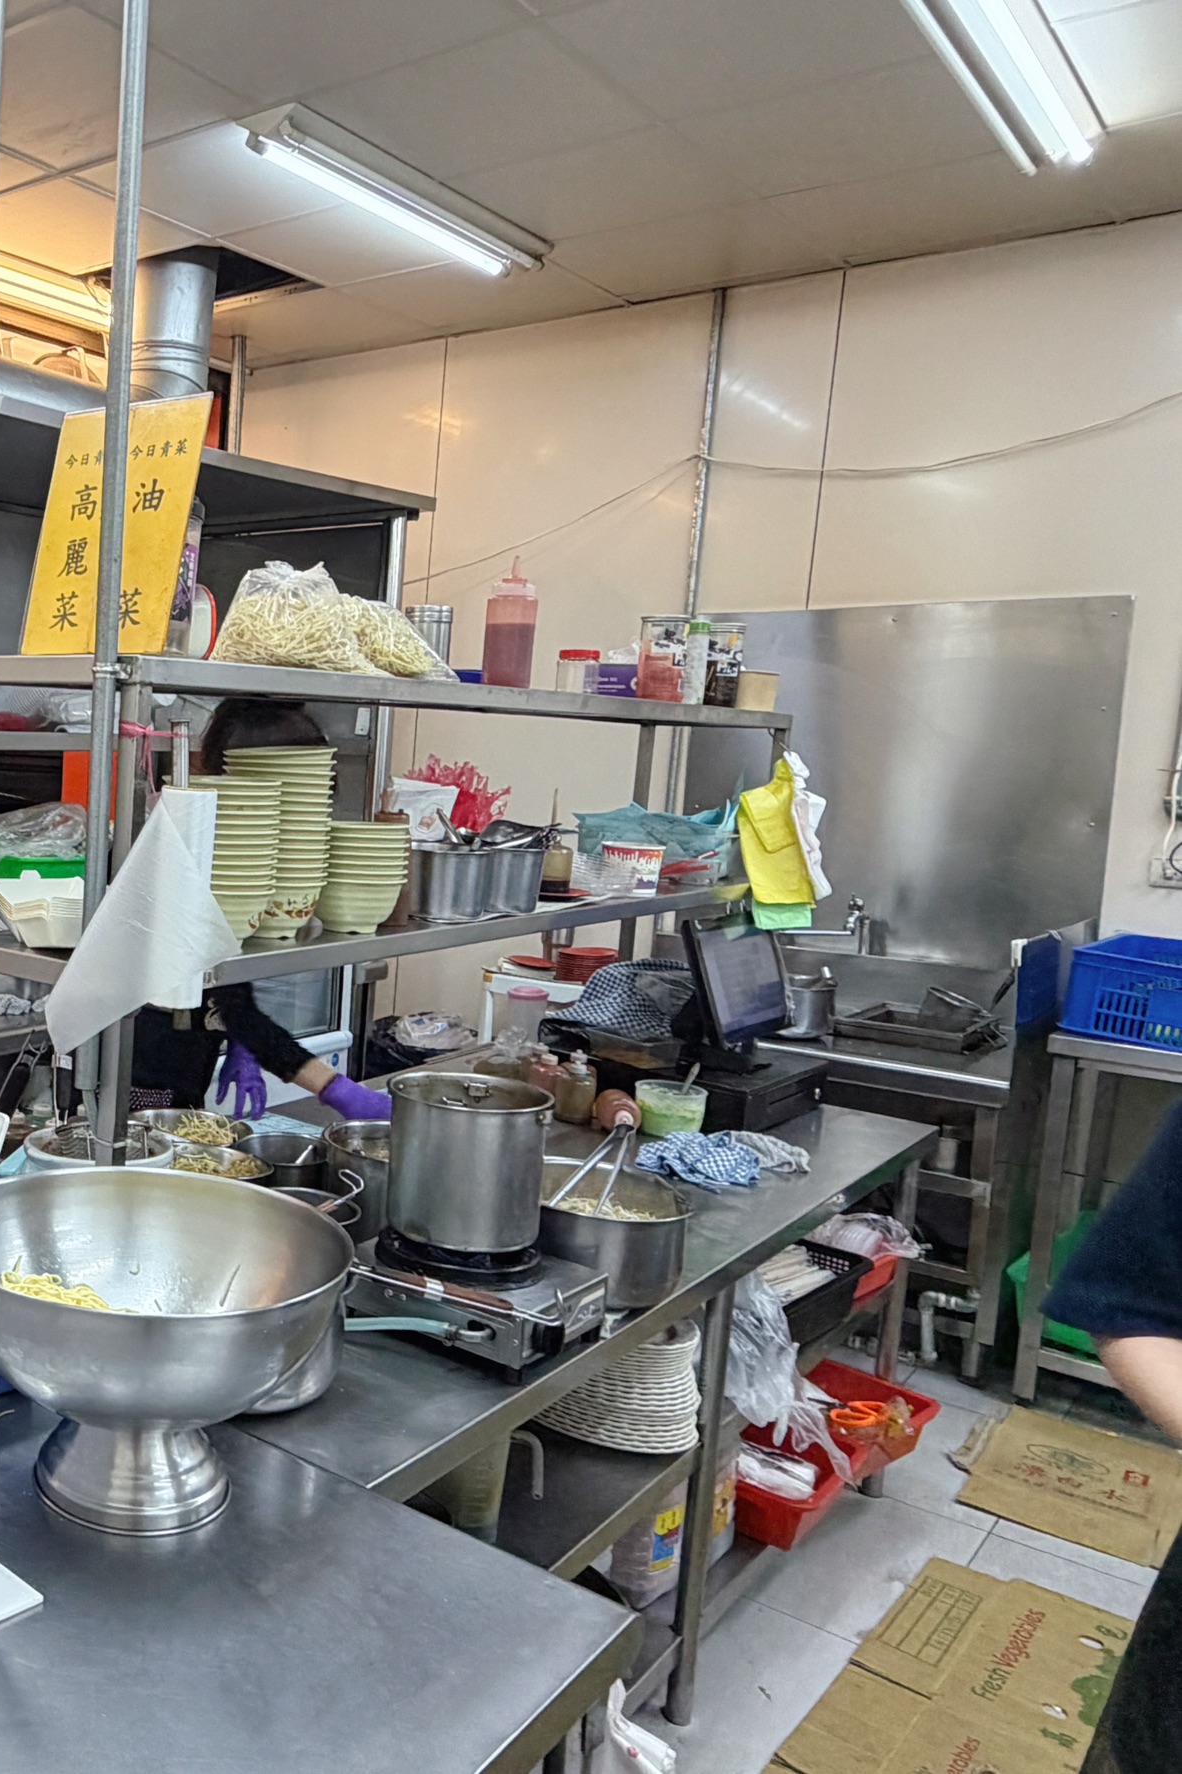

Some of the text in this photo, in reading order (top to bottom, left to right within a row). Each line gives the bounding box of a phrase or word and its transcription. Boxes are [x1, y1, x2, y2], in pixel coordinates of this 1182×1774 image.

[129, 438, 187, 460] 今日青菜
[48, 484, 98, 632] 高麗菜
[971, 1607, 1047, 1701] Fresh Vegetables
